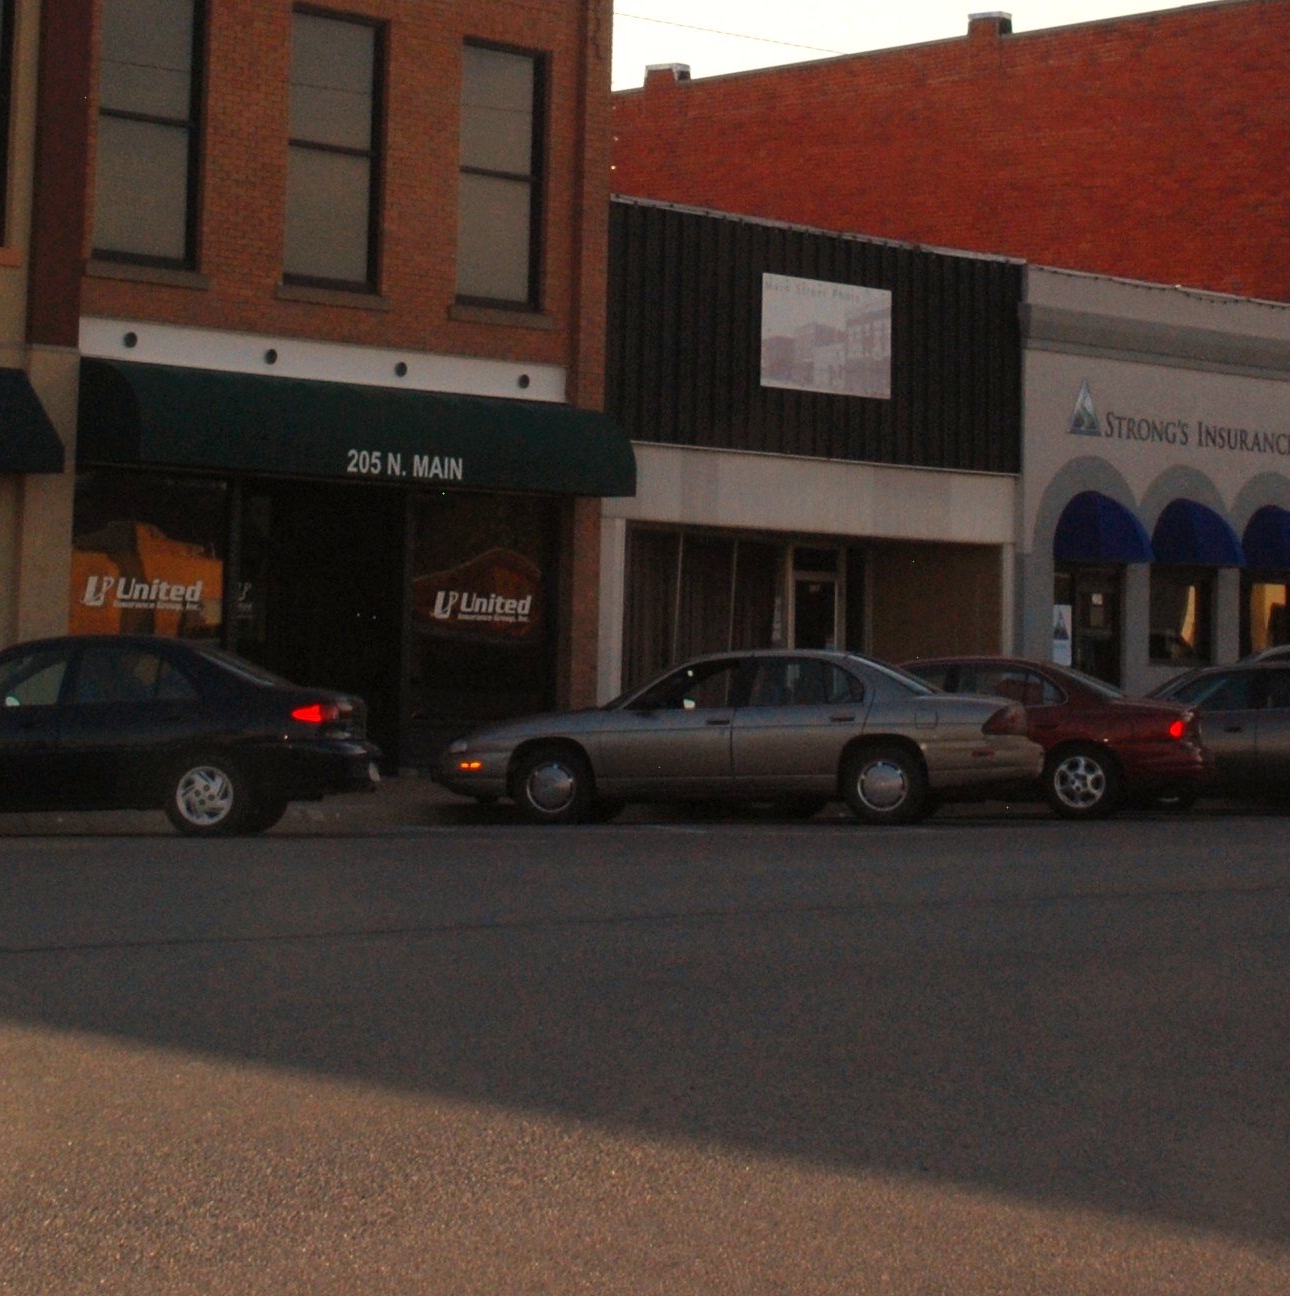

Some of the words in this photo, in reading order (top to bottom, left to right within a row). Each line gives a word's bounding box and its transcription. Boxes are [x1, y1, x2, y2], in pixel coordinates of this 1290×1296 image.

[1104, 411, 1189, 446] STRONG'S
[347, 449, 382, 474] 205
[387, 452, 407, 476] N.
[413, 454, 463, 480] MAIN
[116, 577, 203, 602] United
[460, 592, 532, 615] United
